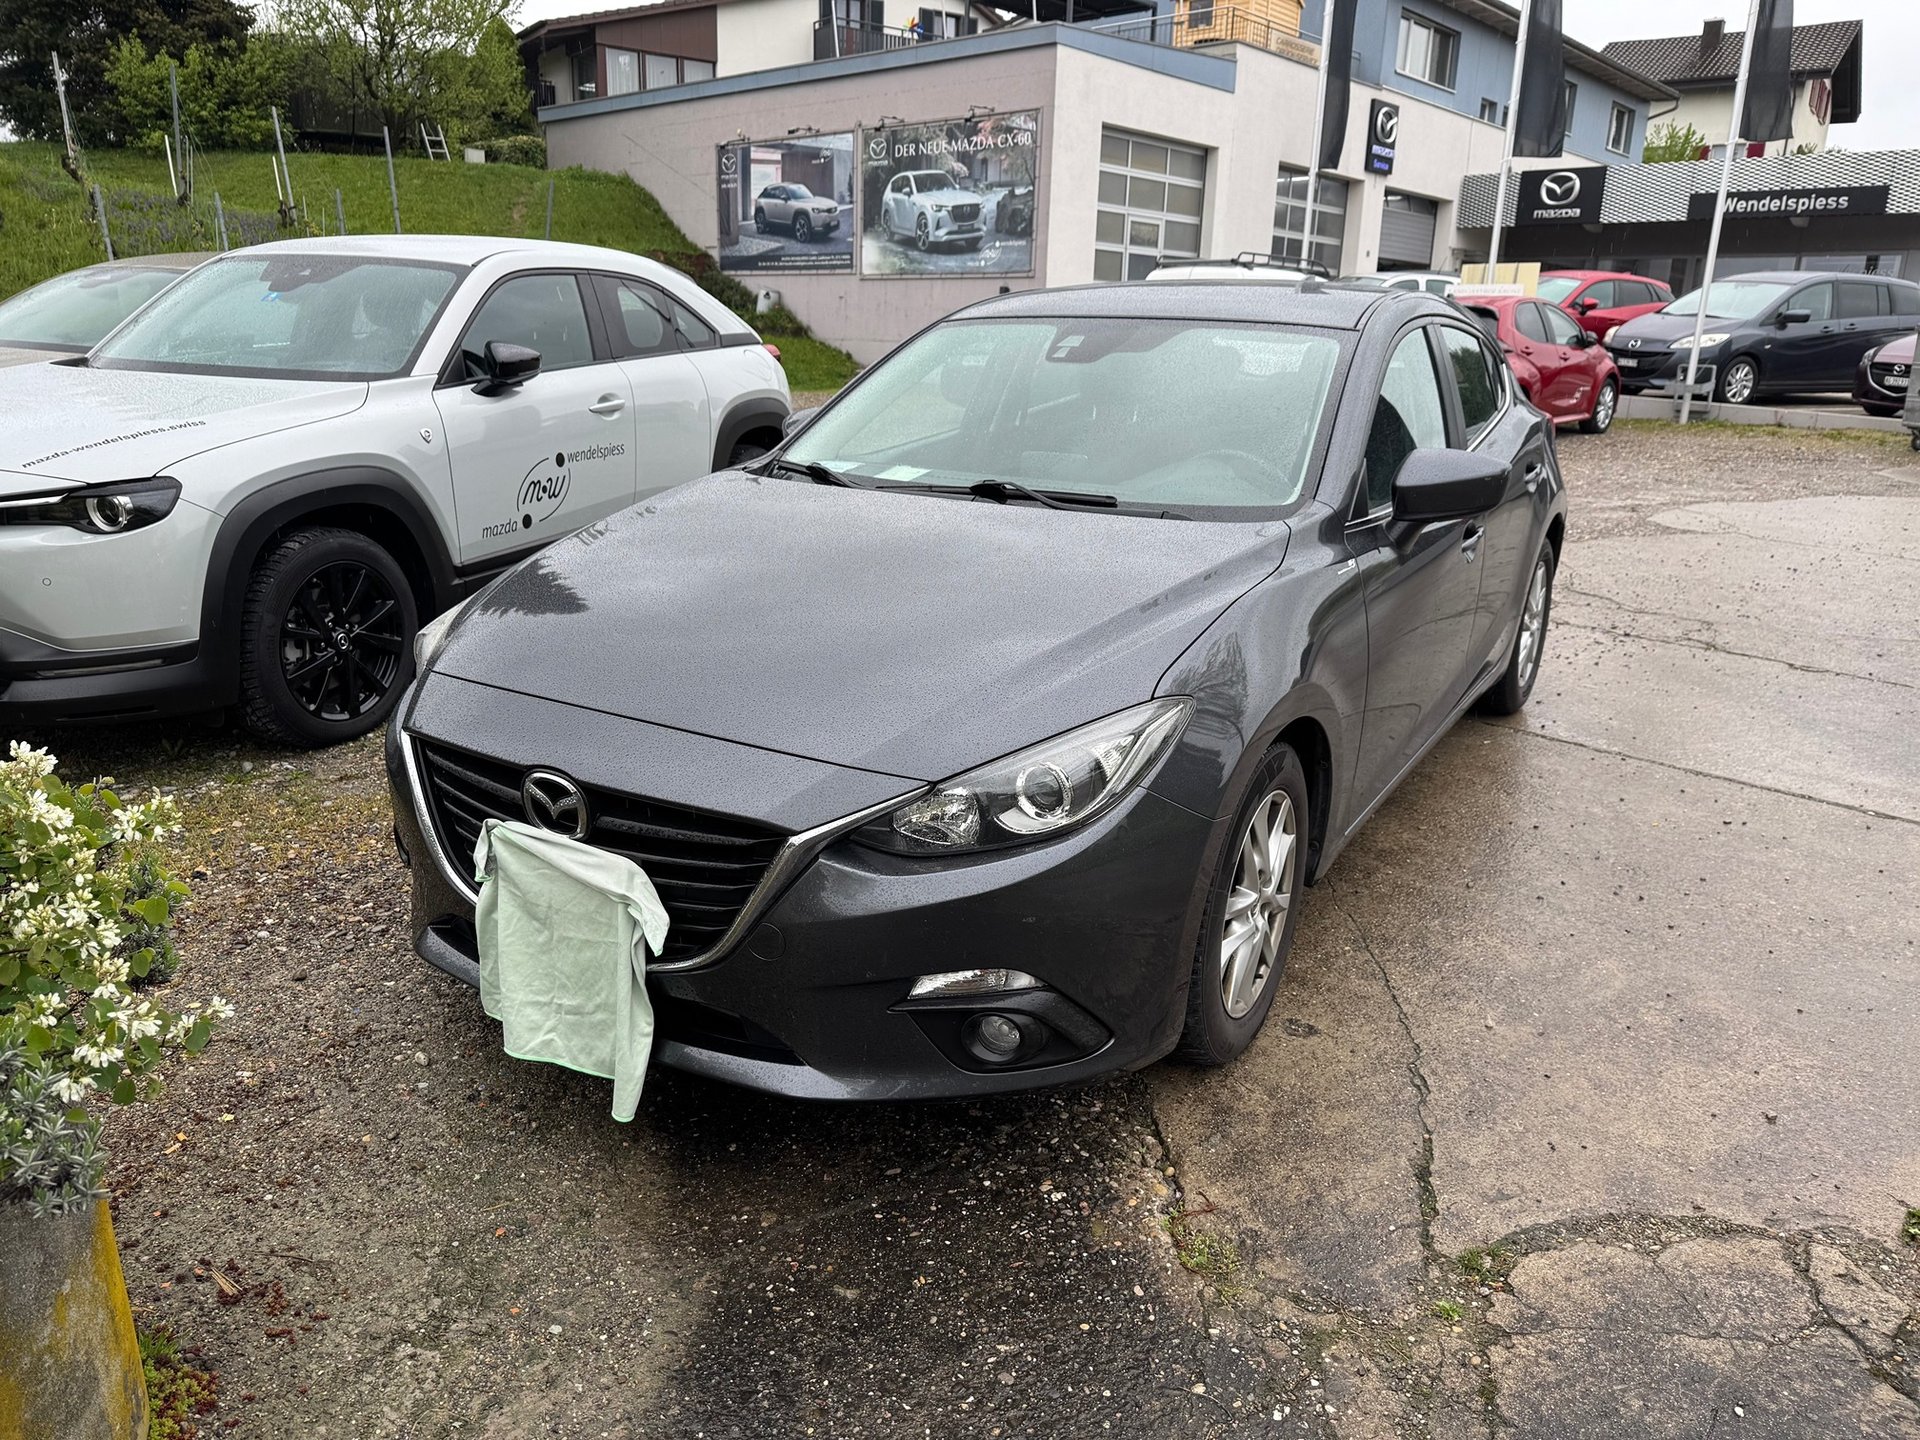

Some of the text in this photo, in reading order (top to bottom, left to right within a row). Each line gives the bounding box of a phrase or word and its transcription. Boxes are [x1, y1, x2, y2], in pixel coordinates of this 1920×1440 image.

[894, 131, 1032, 158] DER NEUE MAZDA CX-60
[1722, 193, 1849, 214] Wendelspiess
[22, 419, 207, 469] mazda-wendelspiess.swiss
[567, 443, 625, 464] wendelspiess
[482, 518, 518, 539] mazda
